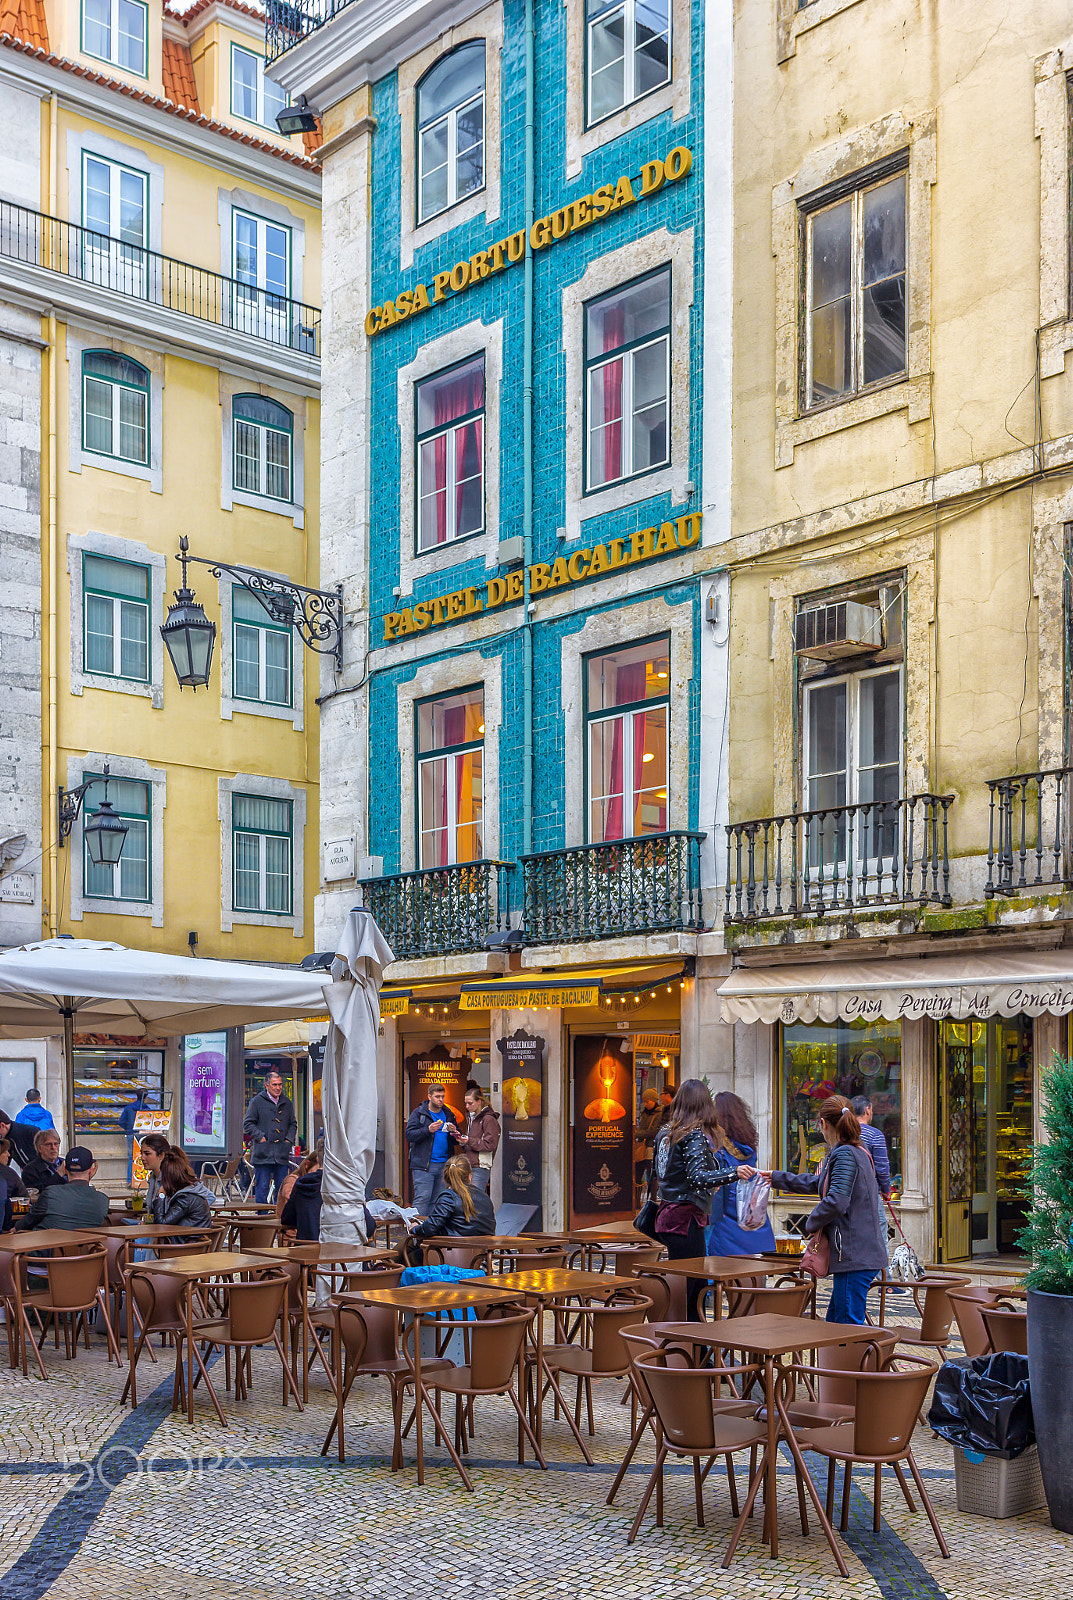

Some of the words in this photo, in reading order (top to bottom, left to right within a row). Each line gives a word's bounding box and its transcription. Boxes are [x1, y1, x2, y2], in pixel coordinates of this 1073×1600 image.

[365, 284, 431, 337] CASA
[433, 175, 637, 304] PORTUGUESA
[640, 145, 694, 197] DO
[383, 586, 483, 641] PASTEL
[486, 572, 524, 608] DE
[528, 511, 704, 594] BACALHAU
[467, 994, 482, 1008] CASA
[482, 993, 519, 1008] PORTUGUESA
[529, 992, 551, 1006] PASTEL
[551, 995, 561, 1005] DE
[561, 990, 594, 1005] BACALHAU
[845, 995, 883, 1015] Casa
[898, 993, 953, 1014] Pereira
[967, 991, 990, 1010] da
[1006, 988, 1073, 1013] Conceiç
[197, 1066, 213, 1076] sem
[189, 1076, 221, 1089] perfume
